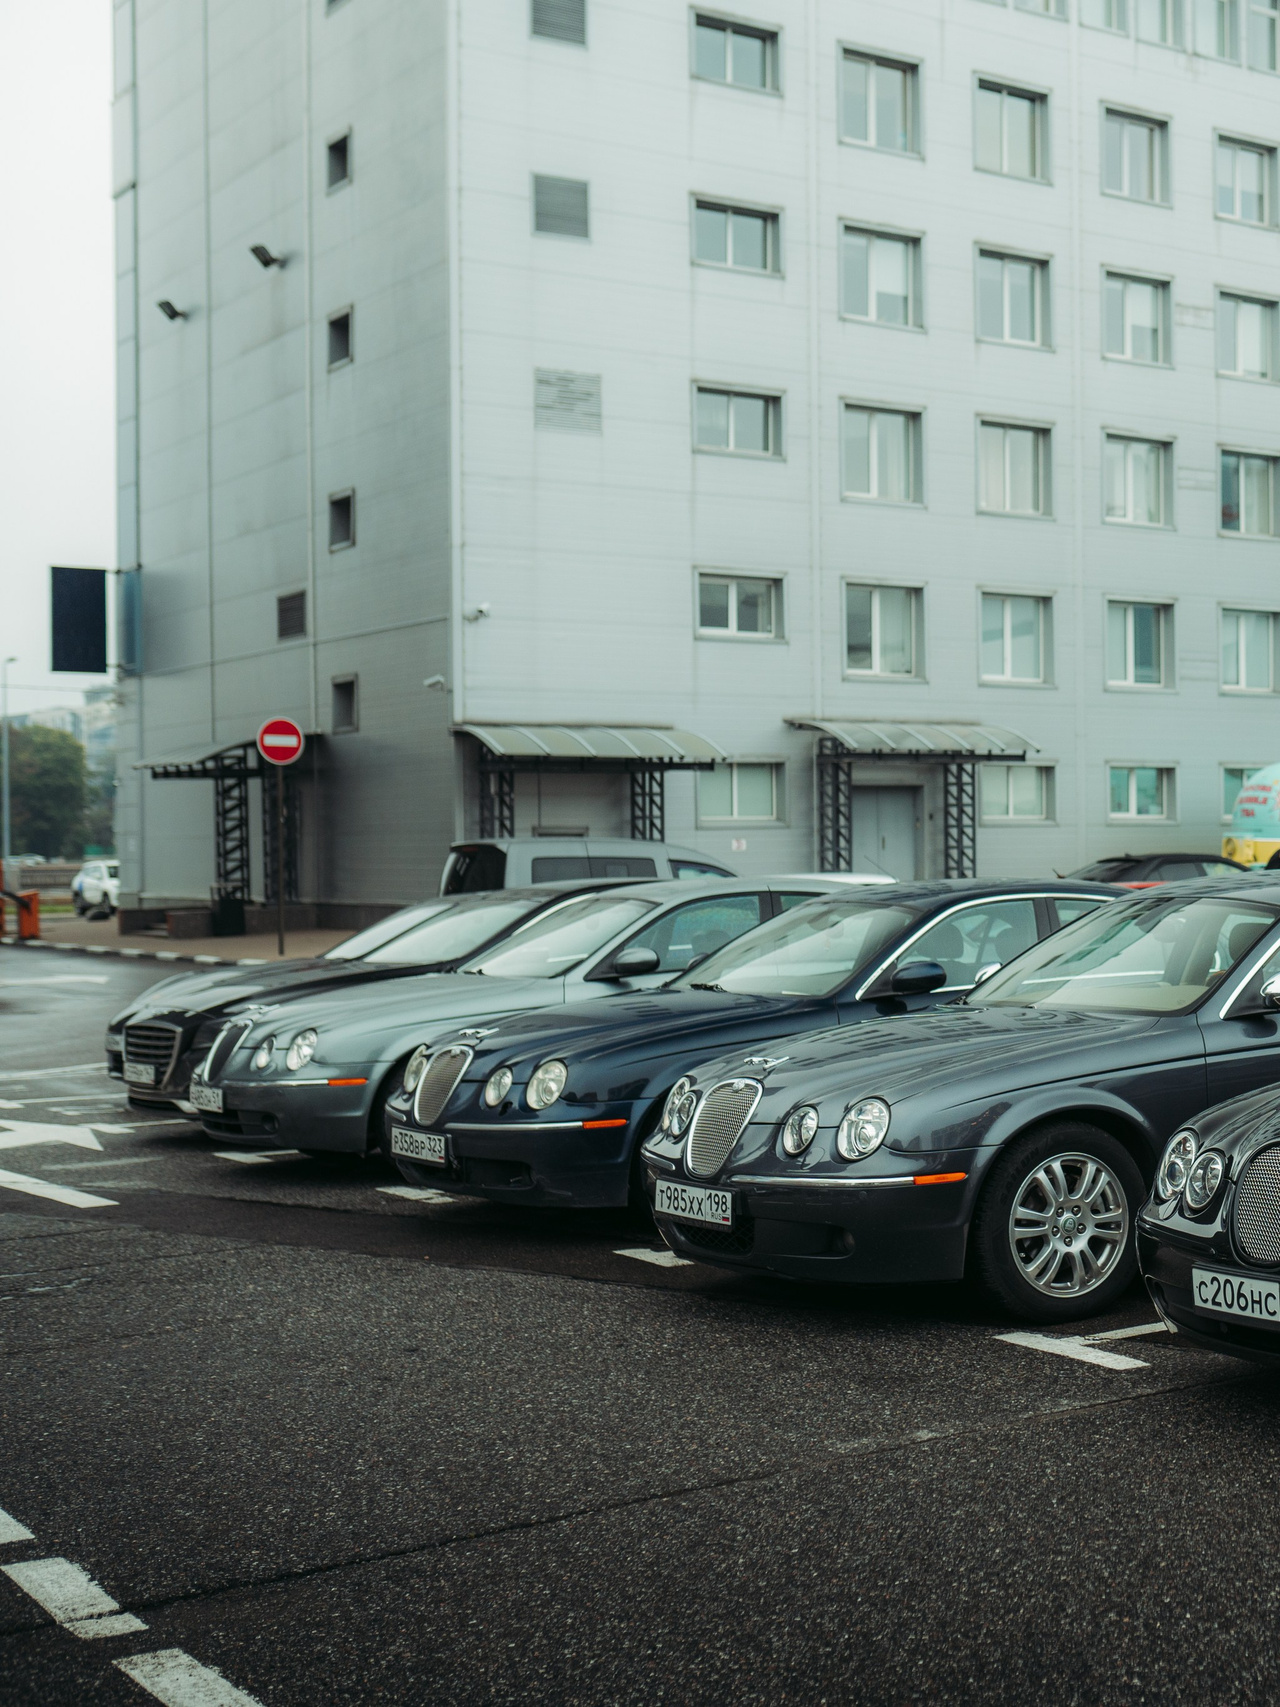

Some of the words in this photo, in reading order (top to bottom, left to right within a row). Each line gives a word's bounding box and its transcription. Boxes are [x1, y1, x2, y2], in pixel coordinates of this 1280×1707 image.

[427, 1136, 443, 1154] 323
[706, 1192, 728, 1213] 198
[711, 1212, 722, 1221] RUS
